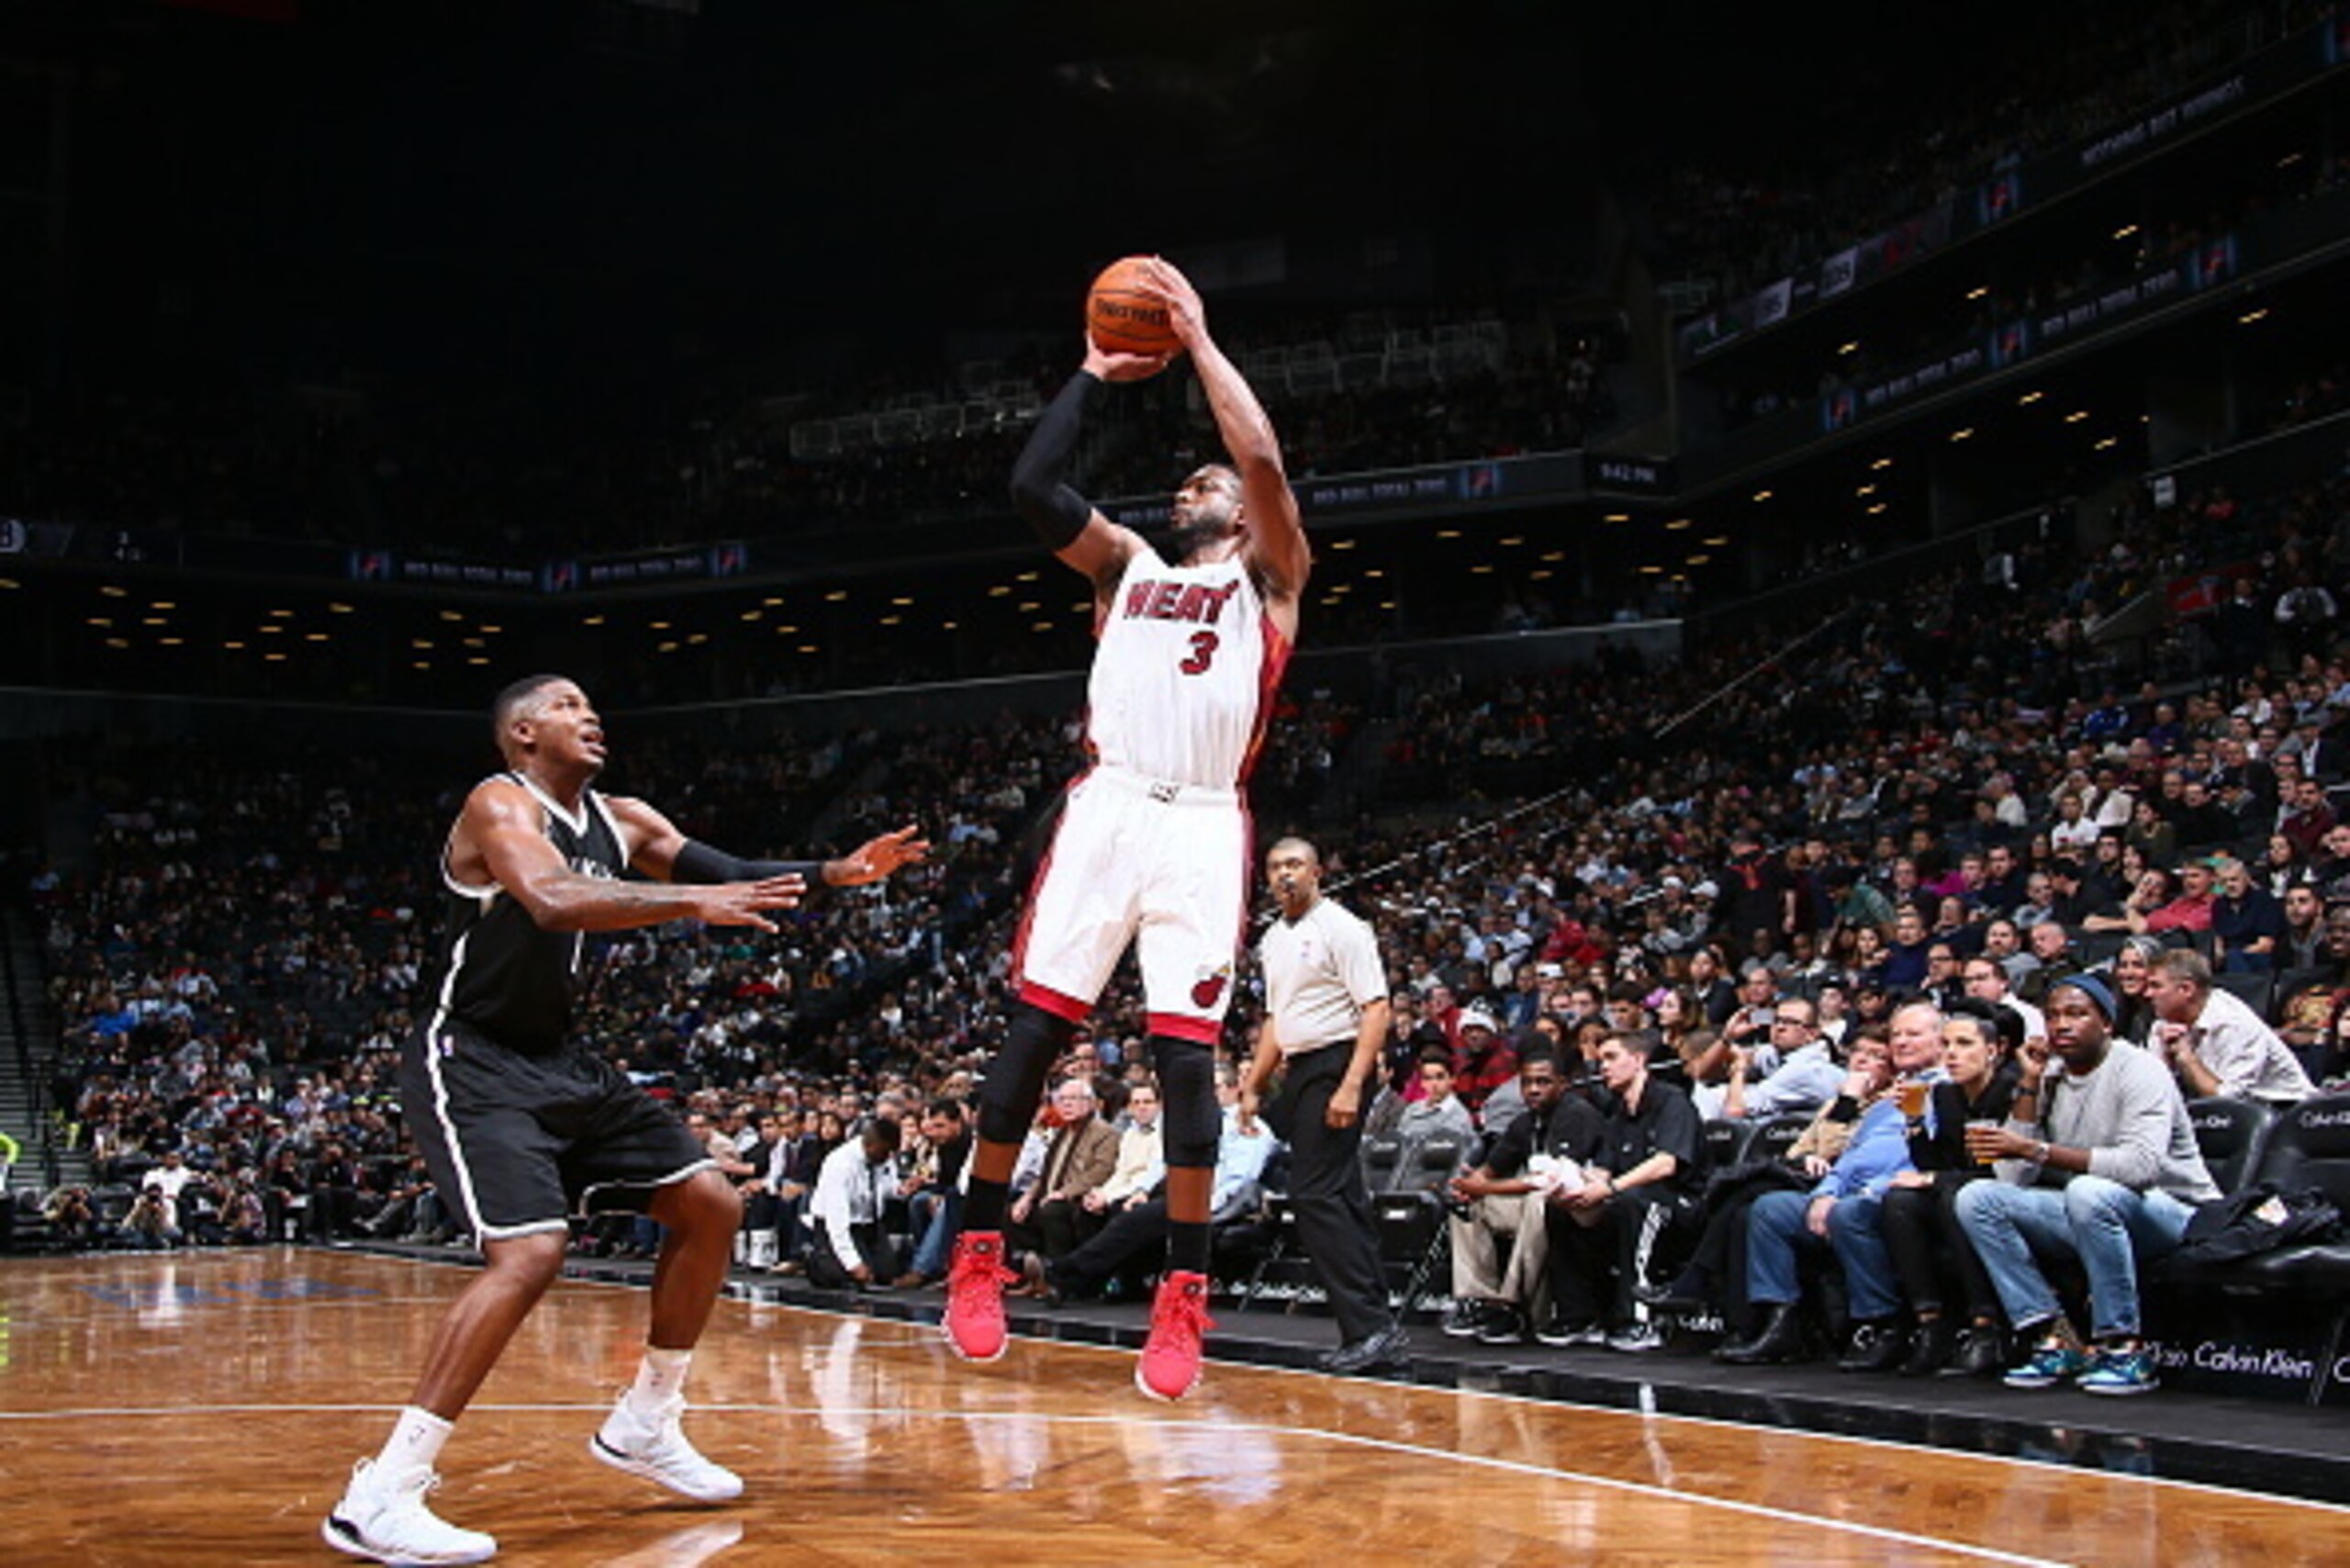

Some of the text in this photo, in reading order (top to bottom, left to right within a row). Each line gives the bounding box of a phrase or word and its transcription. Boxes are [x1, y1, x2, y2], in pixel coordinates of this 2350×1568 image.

[1123, 579, 1239, 625] HEAT
[1179, 630, 1219, 676] 3
[2194, 1340, 2260, 1372] Calvin
[2261, 1347, 2314, 1378] Klein
